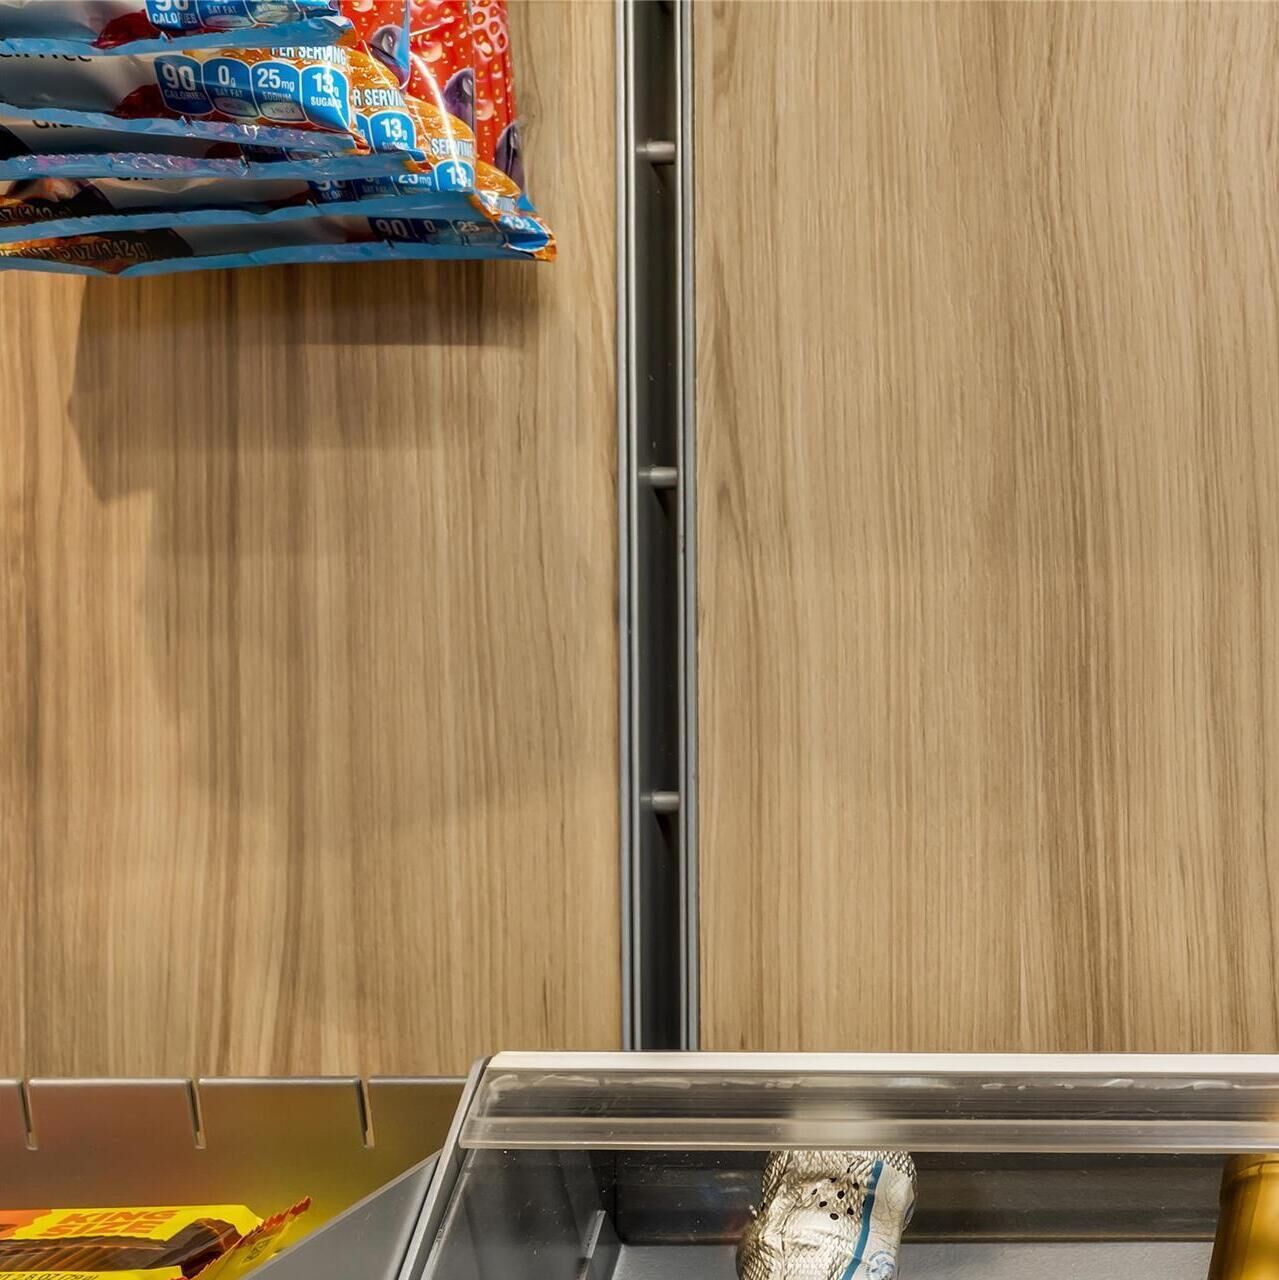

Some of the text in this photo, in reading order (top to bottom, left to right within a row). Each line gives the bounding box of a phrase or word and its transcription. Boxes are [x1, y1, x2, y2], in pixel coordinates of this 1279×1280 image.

[161, 64, 196, 92] 90
[60, 1209, 180, 1224] KING
[39, 1222, 159, 1237] SIZE
